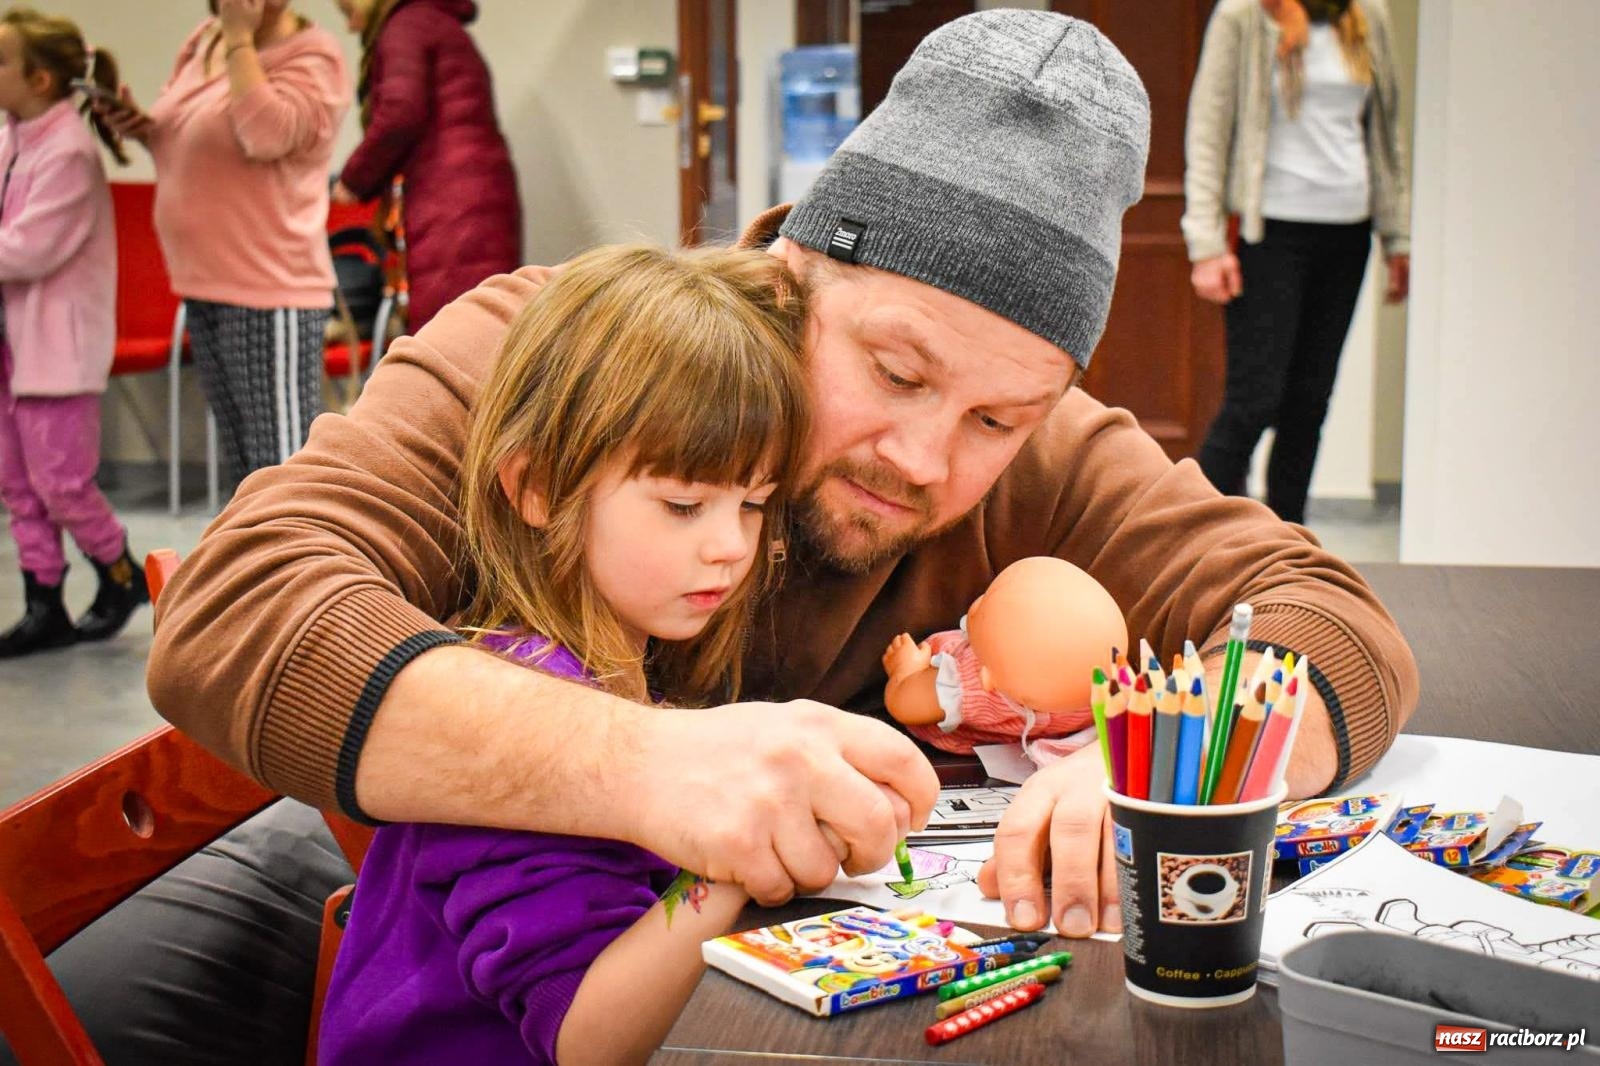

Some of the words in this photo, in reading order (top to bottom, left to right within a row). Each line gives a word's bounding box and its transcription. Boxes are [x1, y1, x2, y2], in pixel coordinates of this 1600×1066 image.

[1299, 840, 1338, 856] Kredki
[1447, 851, 1459, 861] 12
[966, 964, 977, 975] 12
[1156, 966, 1201, 980] Coffee
[919, 968, 955, 988] Kredki
[840, 984, 901, 1008] bambino
